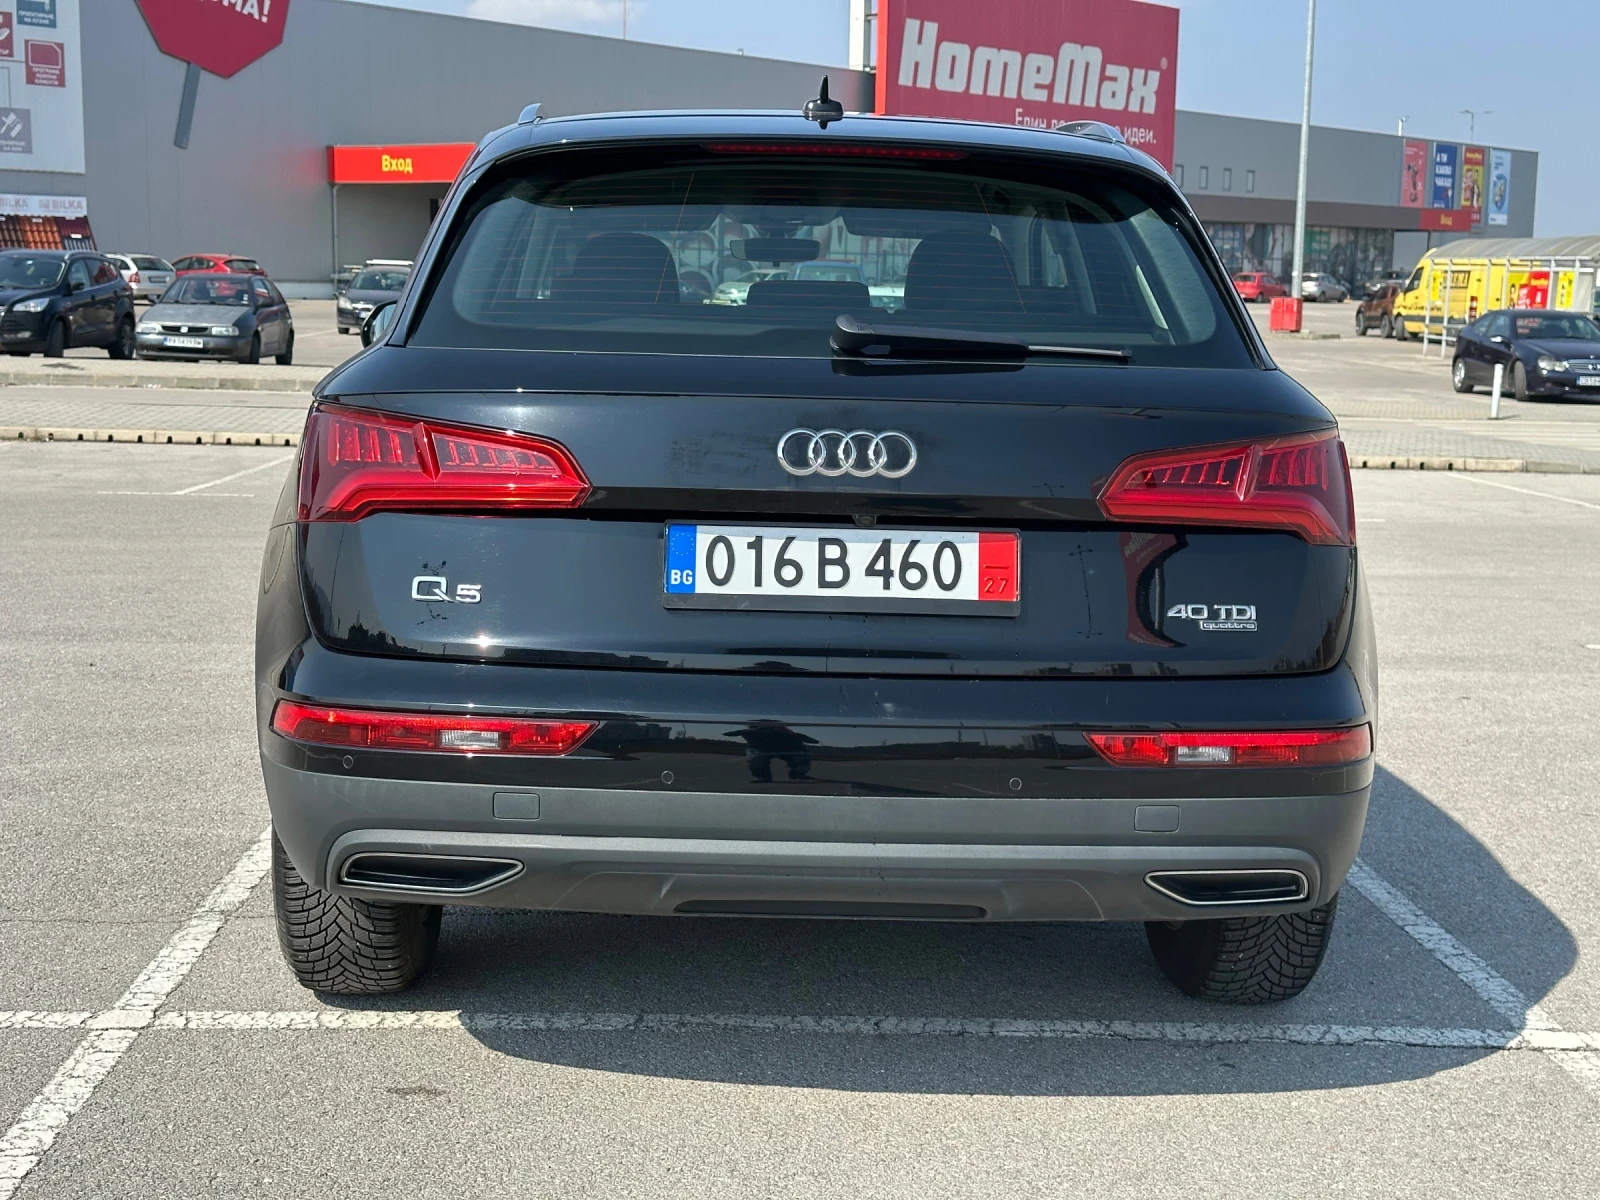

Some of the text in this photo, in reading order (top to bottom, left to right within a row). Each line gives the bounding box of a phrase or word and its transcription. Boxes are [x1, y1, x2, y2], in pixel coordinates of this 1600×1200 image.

[898, 17, 1160, 114] HomeMax
[381, 155, 413, 174] Вход
[52, 199, 83, 210] BILKA
[670, 570, 693, 585] BG
[984, 576, 1008, 594] 27
[1166, 604, 1257, 620] 40 TDI
